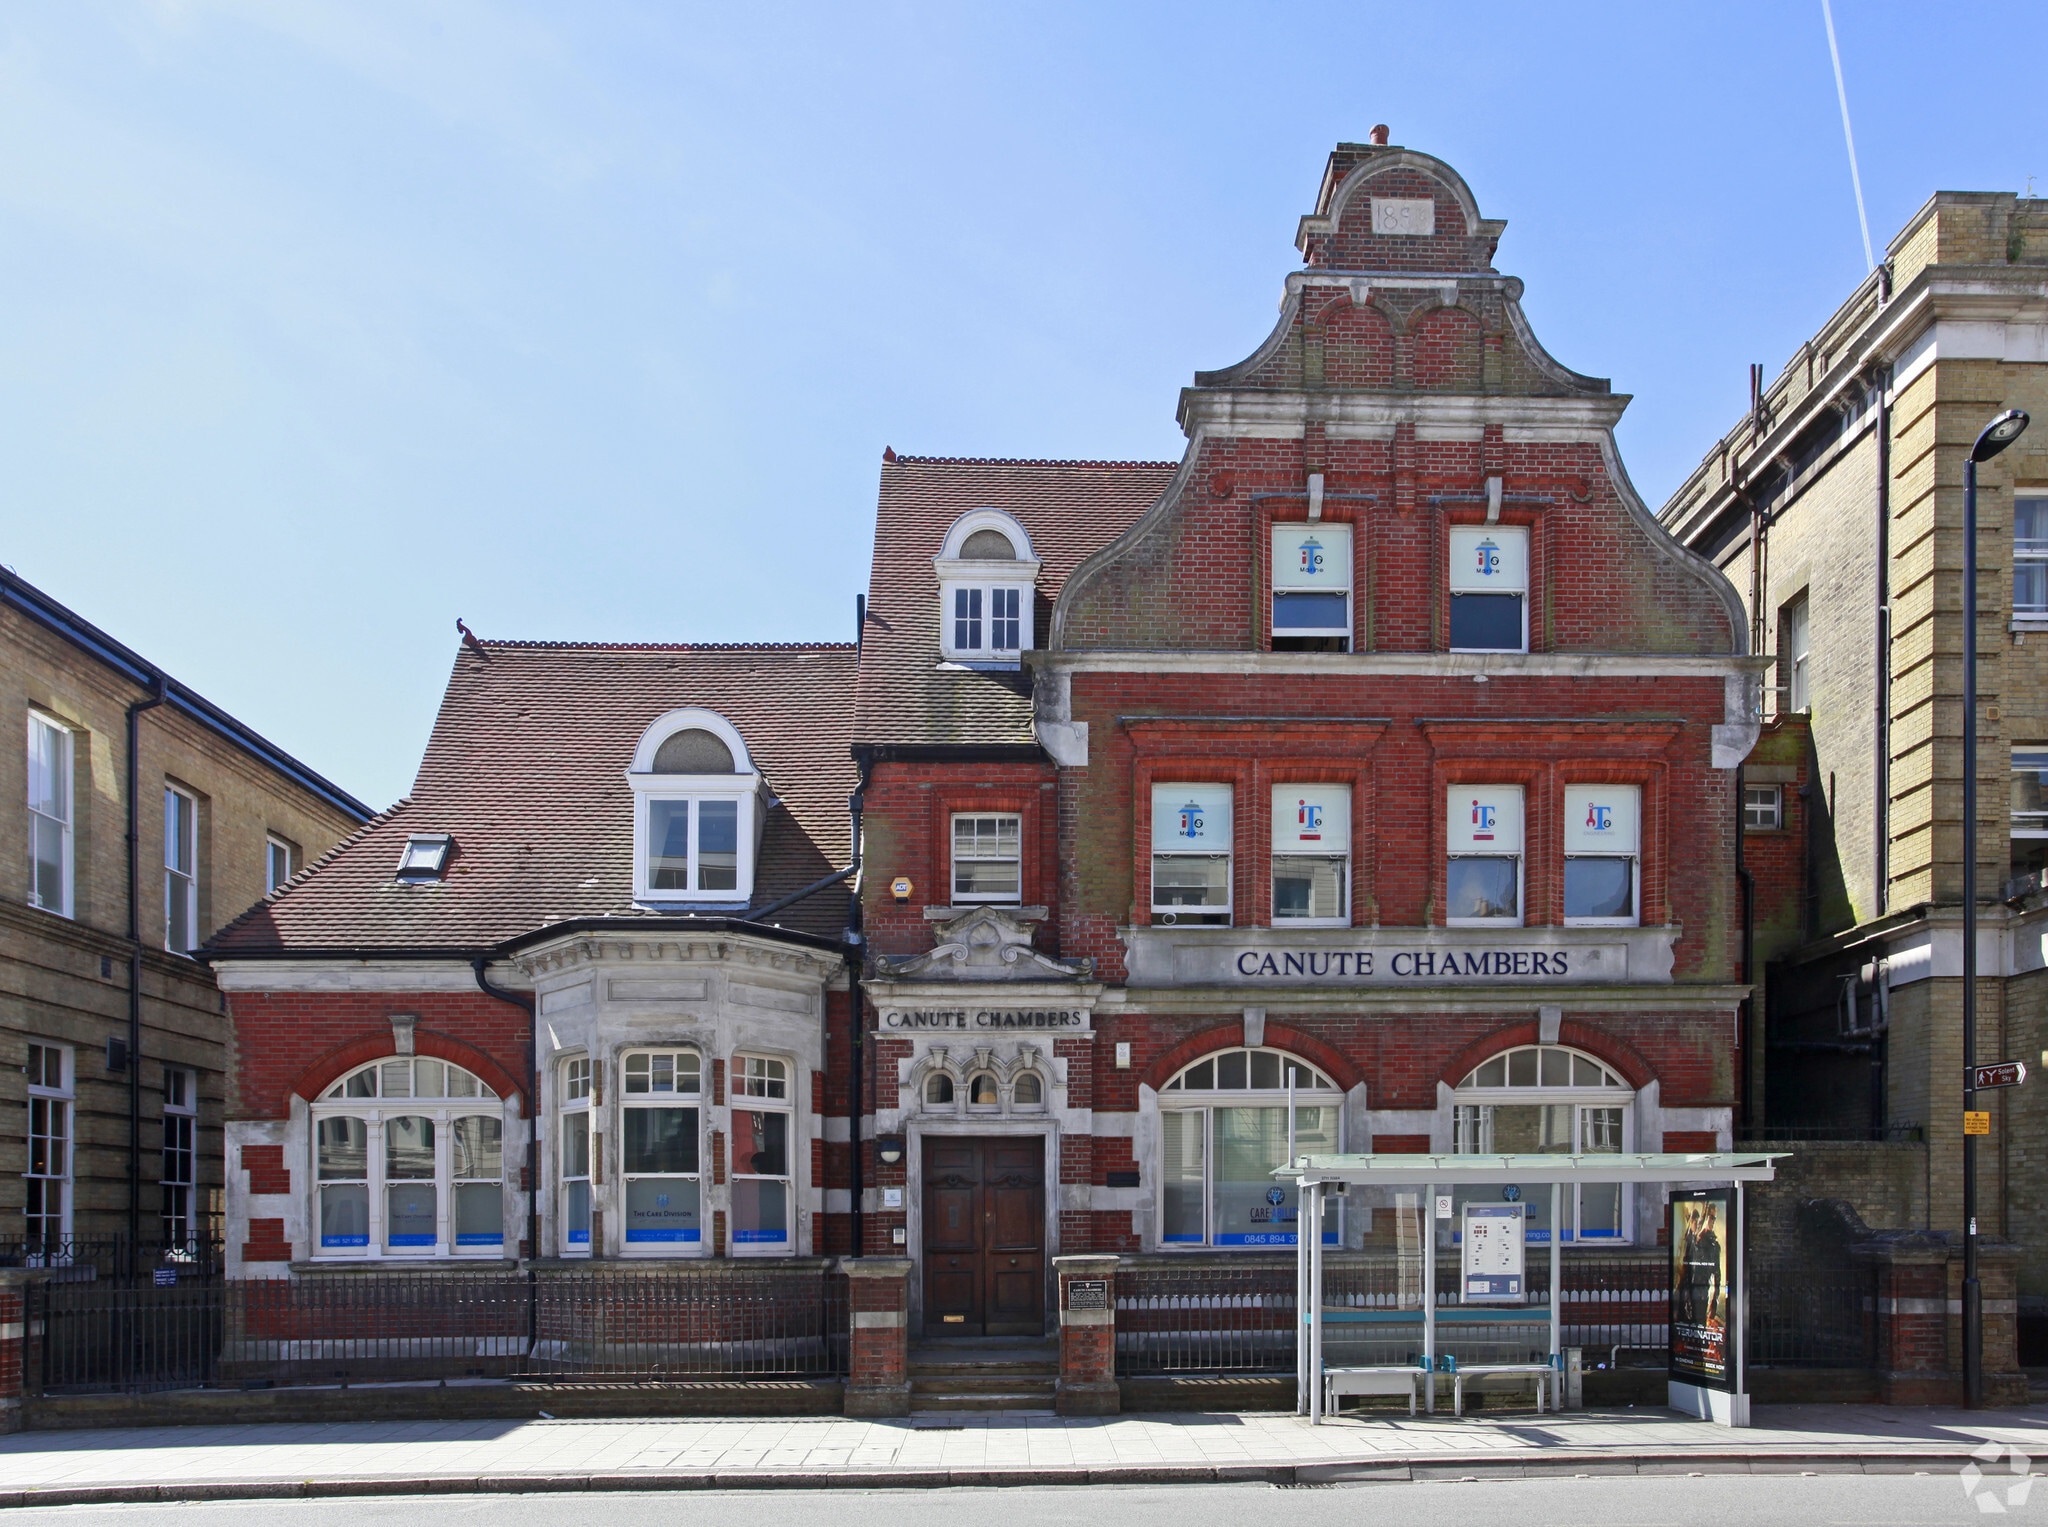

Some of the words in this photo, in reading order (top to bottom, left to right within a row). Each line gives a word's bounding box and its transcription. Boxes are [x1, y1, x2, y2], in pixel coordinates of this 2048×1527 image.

[1236, 951, 1374, 977] CANUTE
[1390, 951, 1569, 977] CHAMBERS
[886, 1012, 967, 1028] CANUTE
[976, 1011, 1081, 1027] CHAMBERS
[1998, 1067, 2016, 1075] Solent
[1250, 1207, 1298, 1218] CARE-ABILIT
[1244, 1234, 1266, 1243] 0845
[1269, 1234, 1285, 1243] 894
[1676, 1326, 1724, 1343] TERMINATOR
